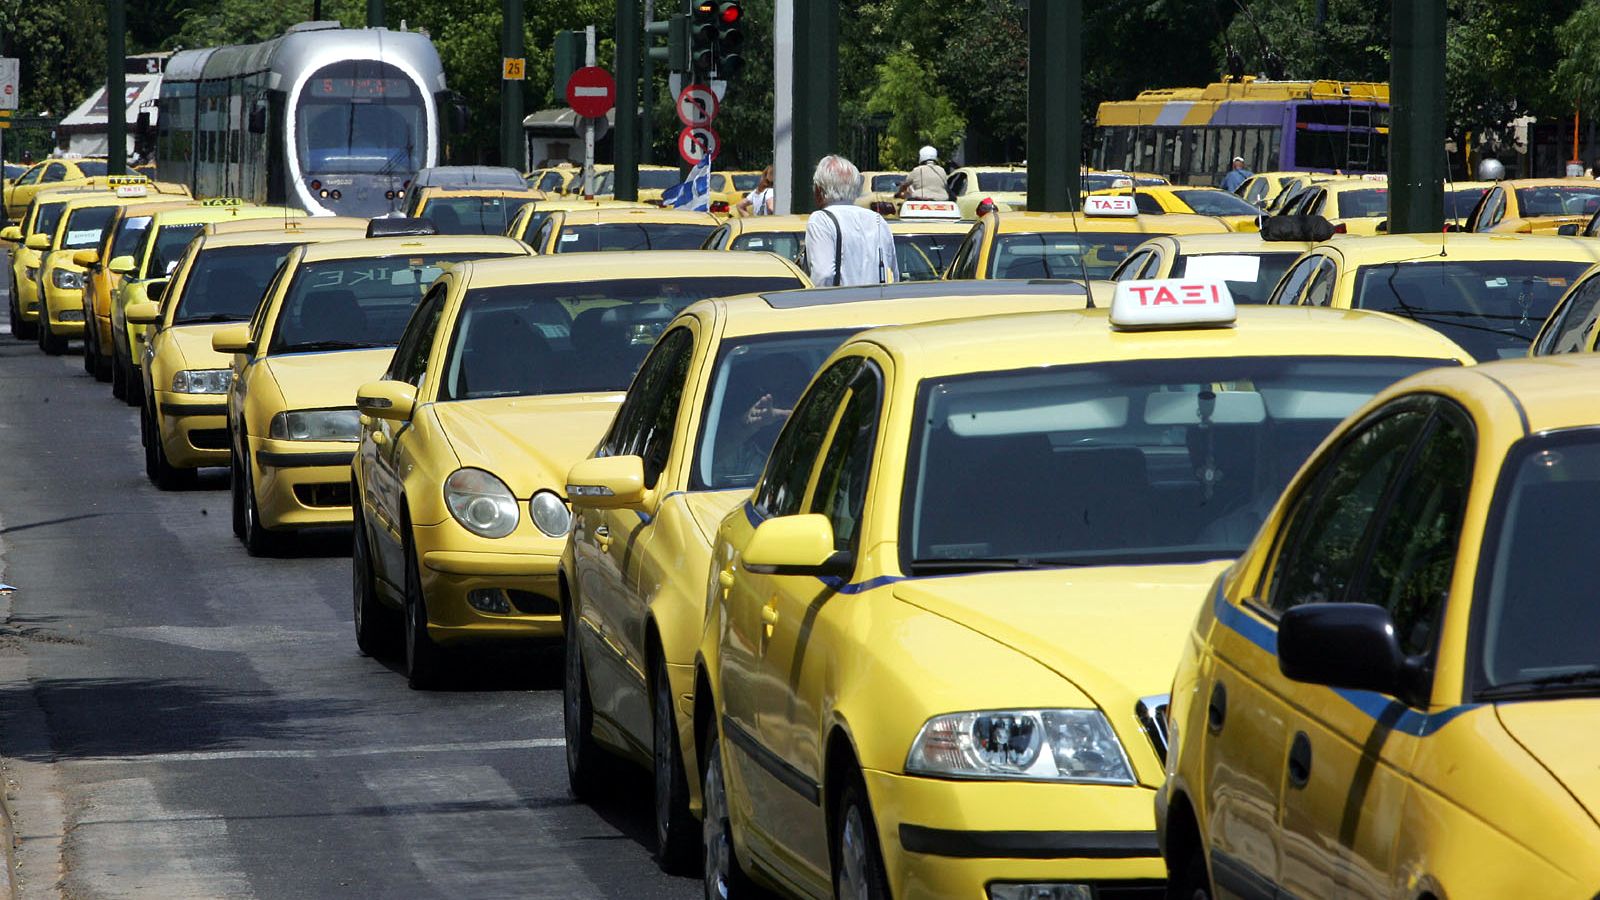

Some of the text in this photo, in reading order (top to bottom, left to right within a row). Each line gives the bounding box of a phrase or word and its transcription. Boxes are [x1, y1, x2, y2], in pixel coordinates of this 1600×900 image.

[508, 63, 520, 74] 25
[203, 198, 239, 206] TAXI
[1091, 200, 1131, 209] ΤΑΞΙ
[1129, 285, 1219, 305] ΤΑΞΙ
